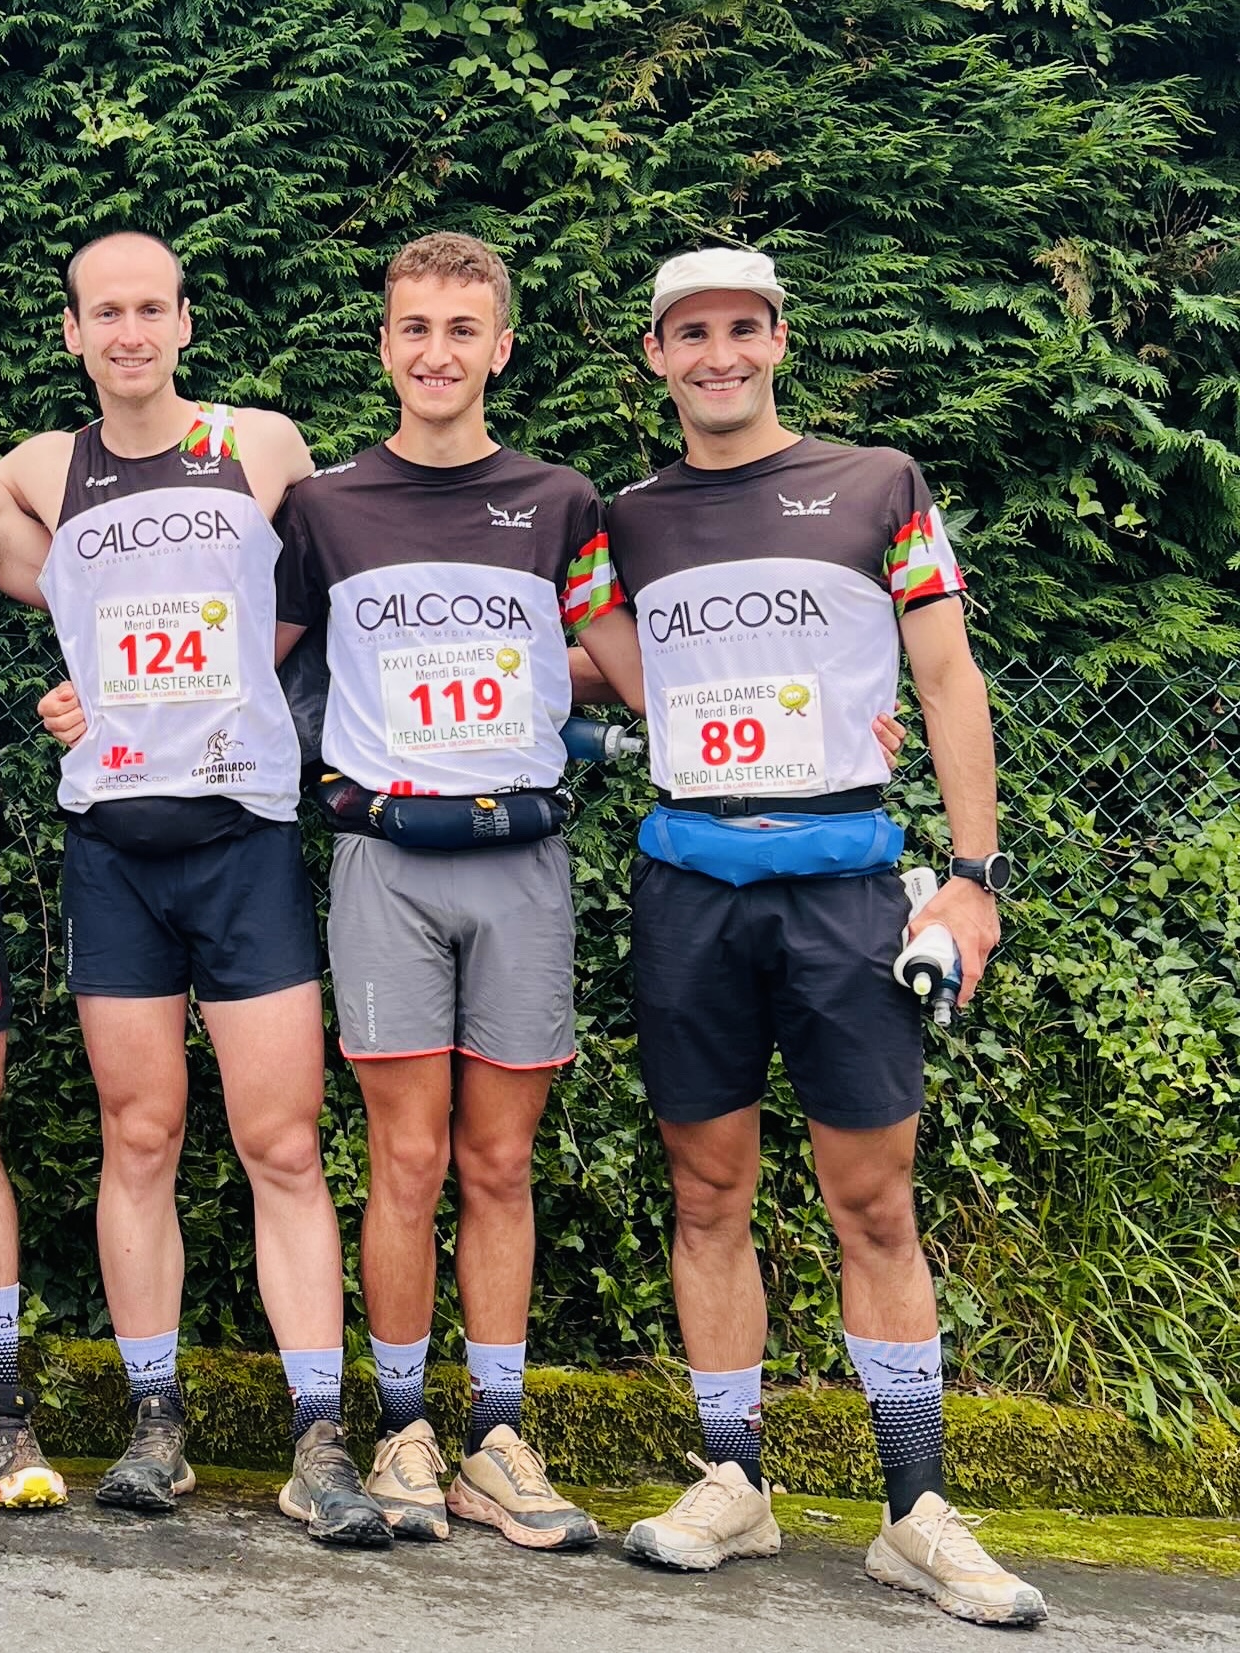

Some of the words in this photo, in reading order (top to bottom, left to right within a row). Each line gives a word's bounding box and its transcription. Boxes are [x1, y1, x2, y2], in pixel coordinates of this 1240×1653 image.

[77, 509, 241, 560] CALCOSA
[98, 605, 124, 620] XXVI
[126, 601, 201, 616] GALDAMES
[356, 592, 533, 632] CALCOSA
[648, 588, 830, 644] CALCOSA
[124, 618, 155, 631] Mendi
[158, 618, 180, 629] Bira
[118, 630, 208, 677] 124
[382, 654, 413, 672] XXVI
[416, 647, 495, 668] GALDAMES
[103, 679, 140, 693] MENDI
[144, 674, 232, 691] LASTERKETA
[415, 667, 450, 682] Mendi
[454, 665, 476, 679] Bira
[408, 677, 504, 727] 119
[670, 693, 695, 710] XXVI
[696, 684, 776, 706] GALDAMES
[695, 706, 727, 720] Mendi
[730, 704, 754, 717] Bira
[392, 728, 436, 745] MENDI
[440, 722, 527, 741] LASTERKETA
[700, 718, 766, 767] 89
[191, 761, 257, 777] GRANALLADOS
[205, 774, 229, 785] JOMI
[674, 771, 712, 786] MENDI
[715, 763, 817, 783] LASTERKETA
[365, 981, 377, 1043] SALOMON
